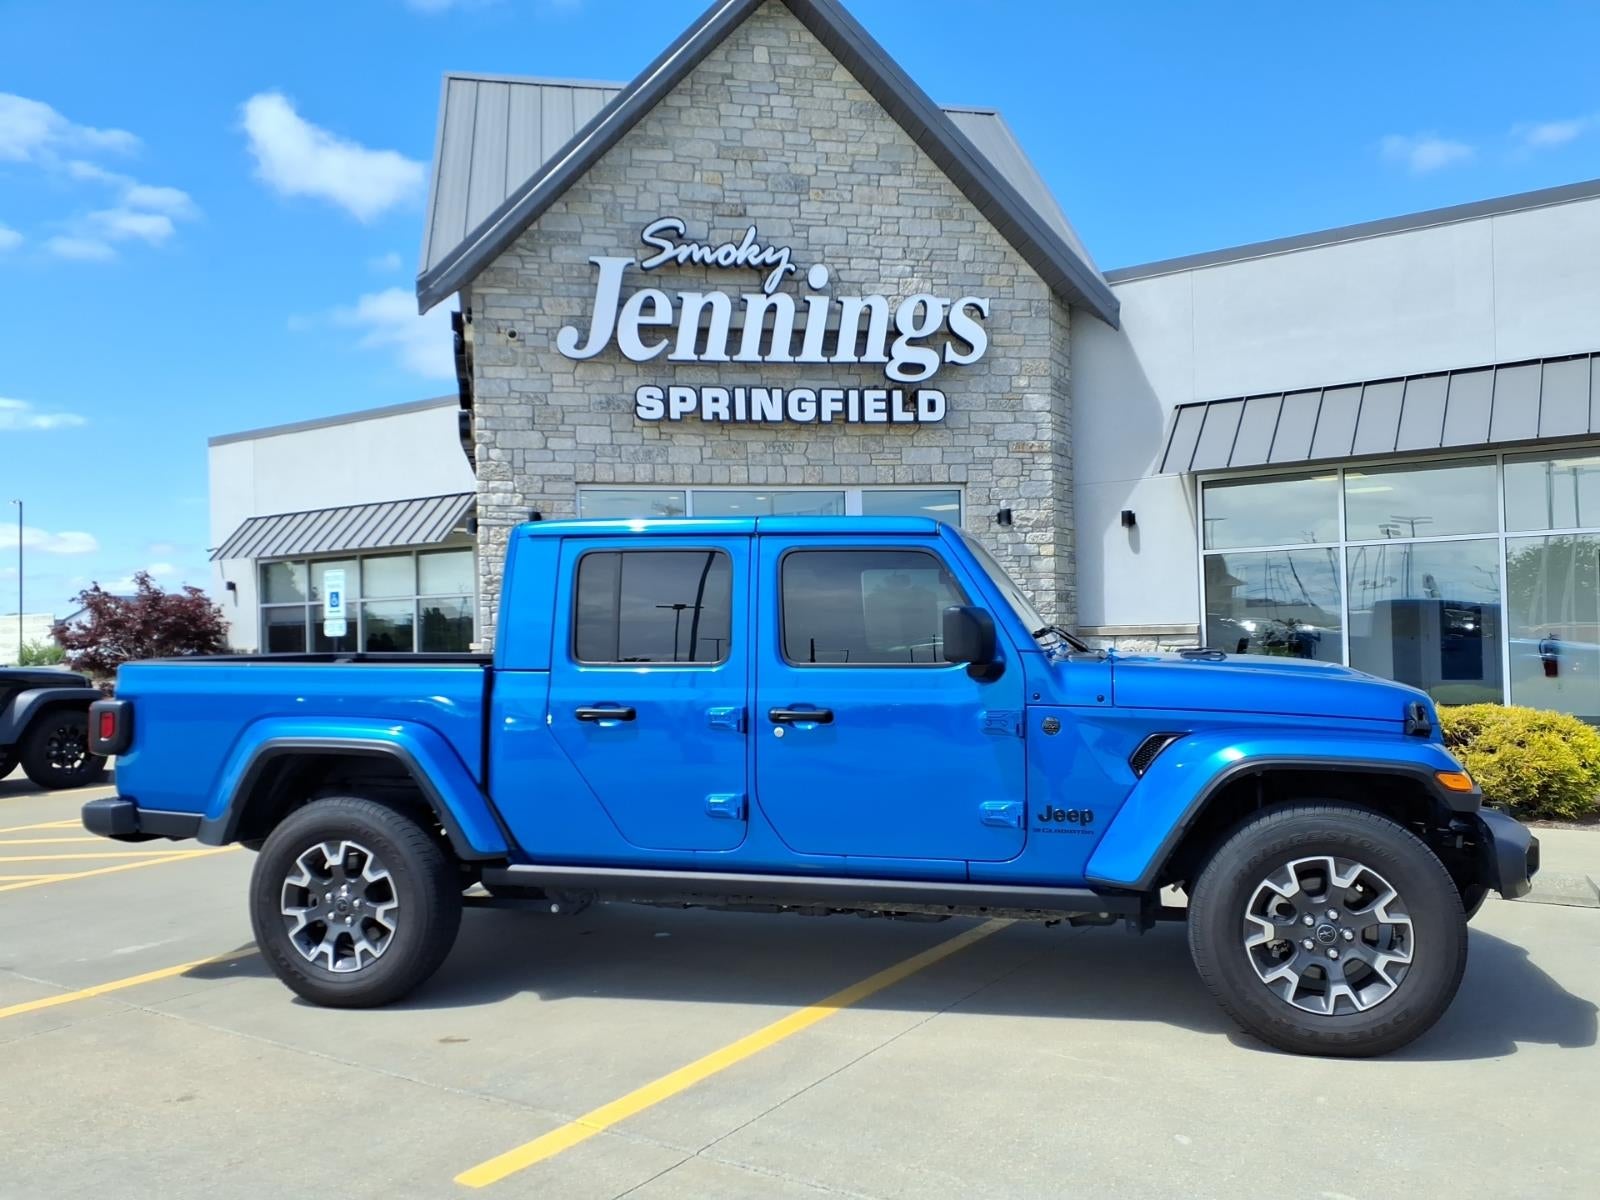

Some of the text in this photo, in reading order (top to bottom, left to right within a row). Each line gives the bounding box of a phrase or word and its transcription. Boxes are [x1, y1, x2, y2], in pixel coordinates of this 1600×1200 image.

[641, 217, 796, 293] Smoky
[556, 256, 991, 382] Jennings
[634, 385, 947, 423] SPRINGFIELD
[1038, 804, 1094, 826] Jeep
